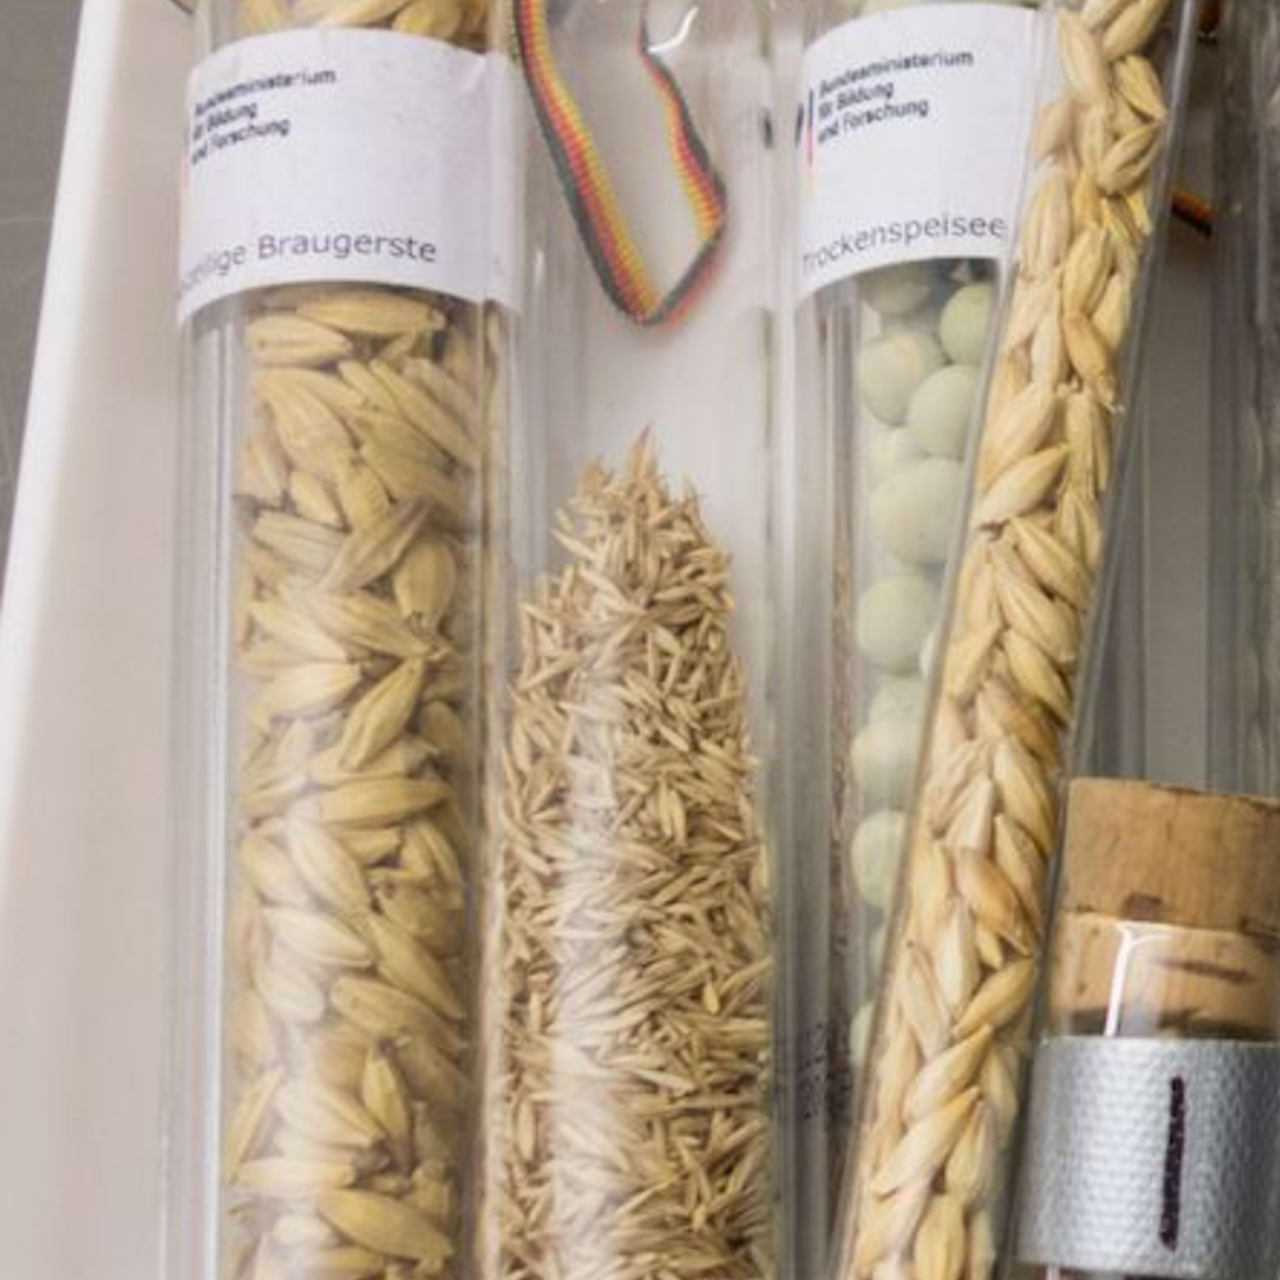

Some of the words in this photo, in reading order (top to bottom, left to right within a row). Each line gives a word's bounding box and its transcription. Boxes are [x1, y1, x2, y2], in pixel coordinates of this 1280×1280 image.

[819, 51, 974, 98] Bundesministerium
[837, 81, 895, 111] Bildung
[843, 100, 930, 132] Forschung
[257, 232, 437, 262] Braugerste
